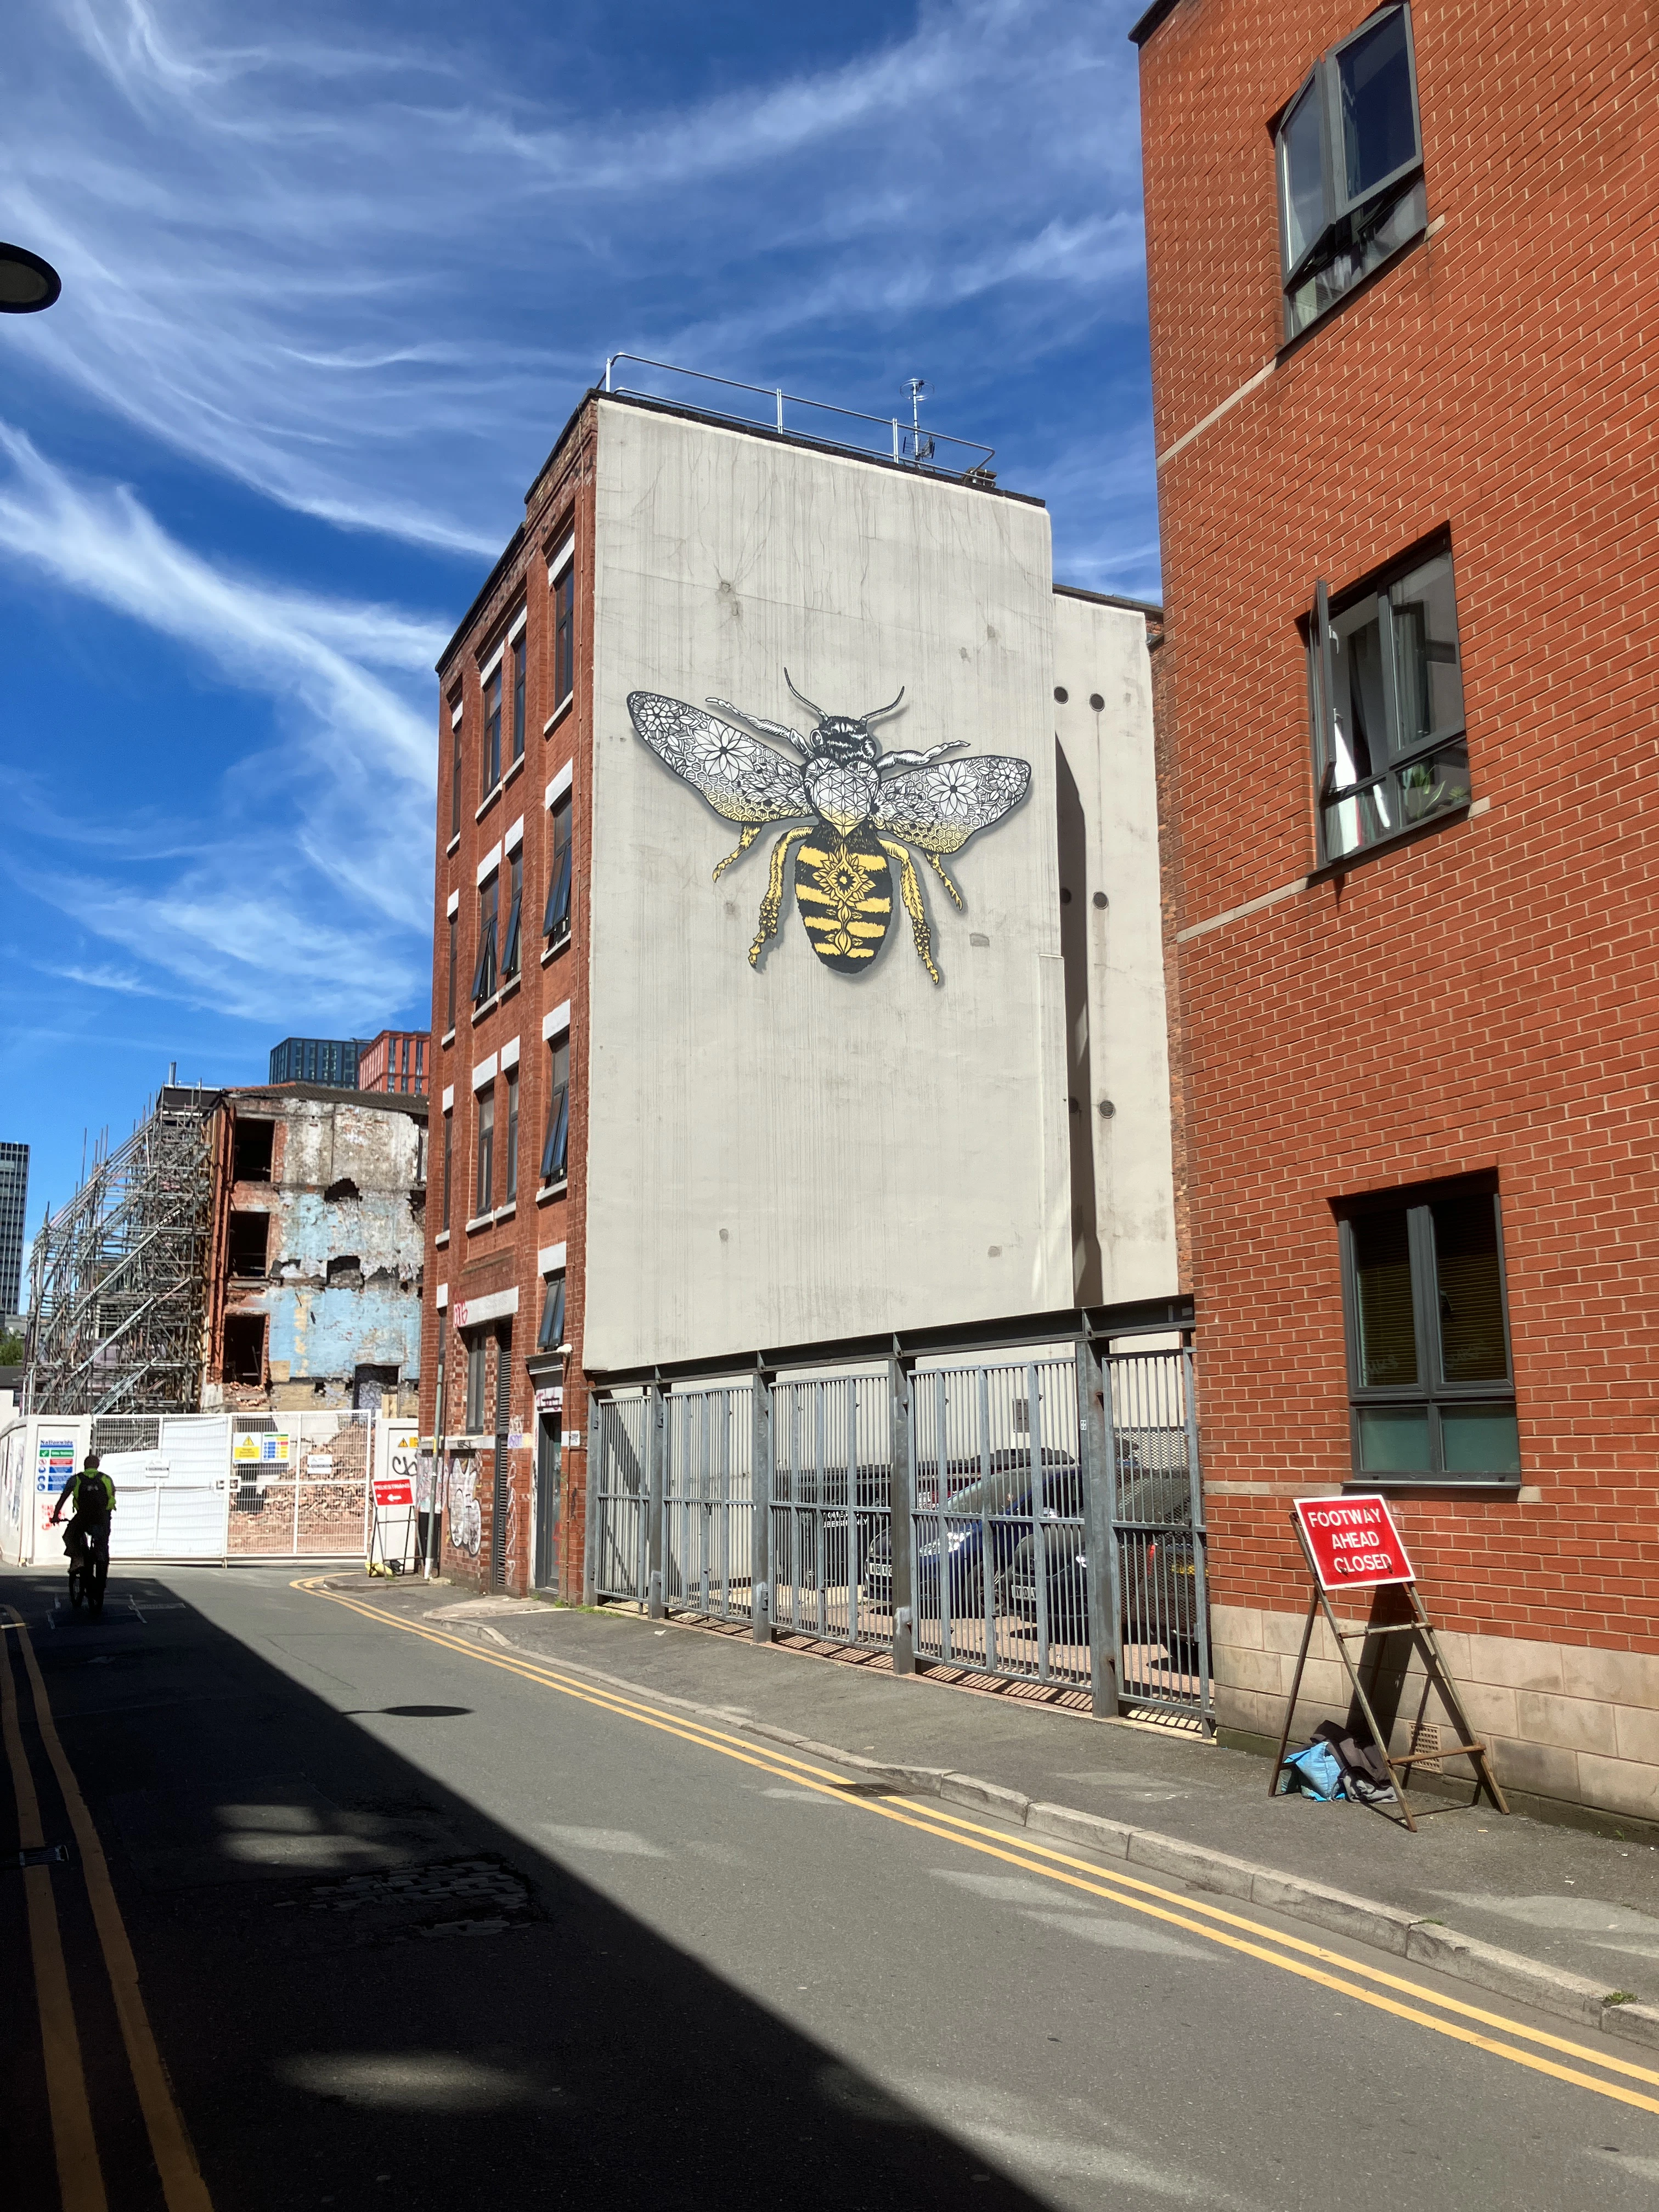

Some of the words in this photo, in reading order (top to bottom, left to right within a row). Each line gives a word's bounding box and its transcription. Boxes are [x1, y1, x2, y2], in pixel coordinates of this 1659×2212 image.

[1307, 1508, 1381, 1527] FOOTWAY
[1331, 1531, 1380, 1550] AHEAD
[1334, 1554, 1392, 1573] CLOSED
